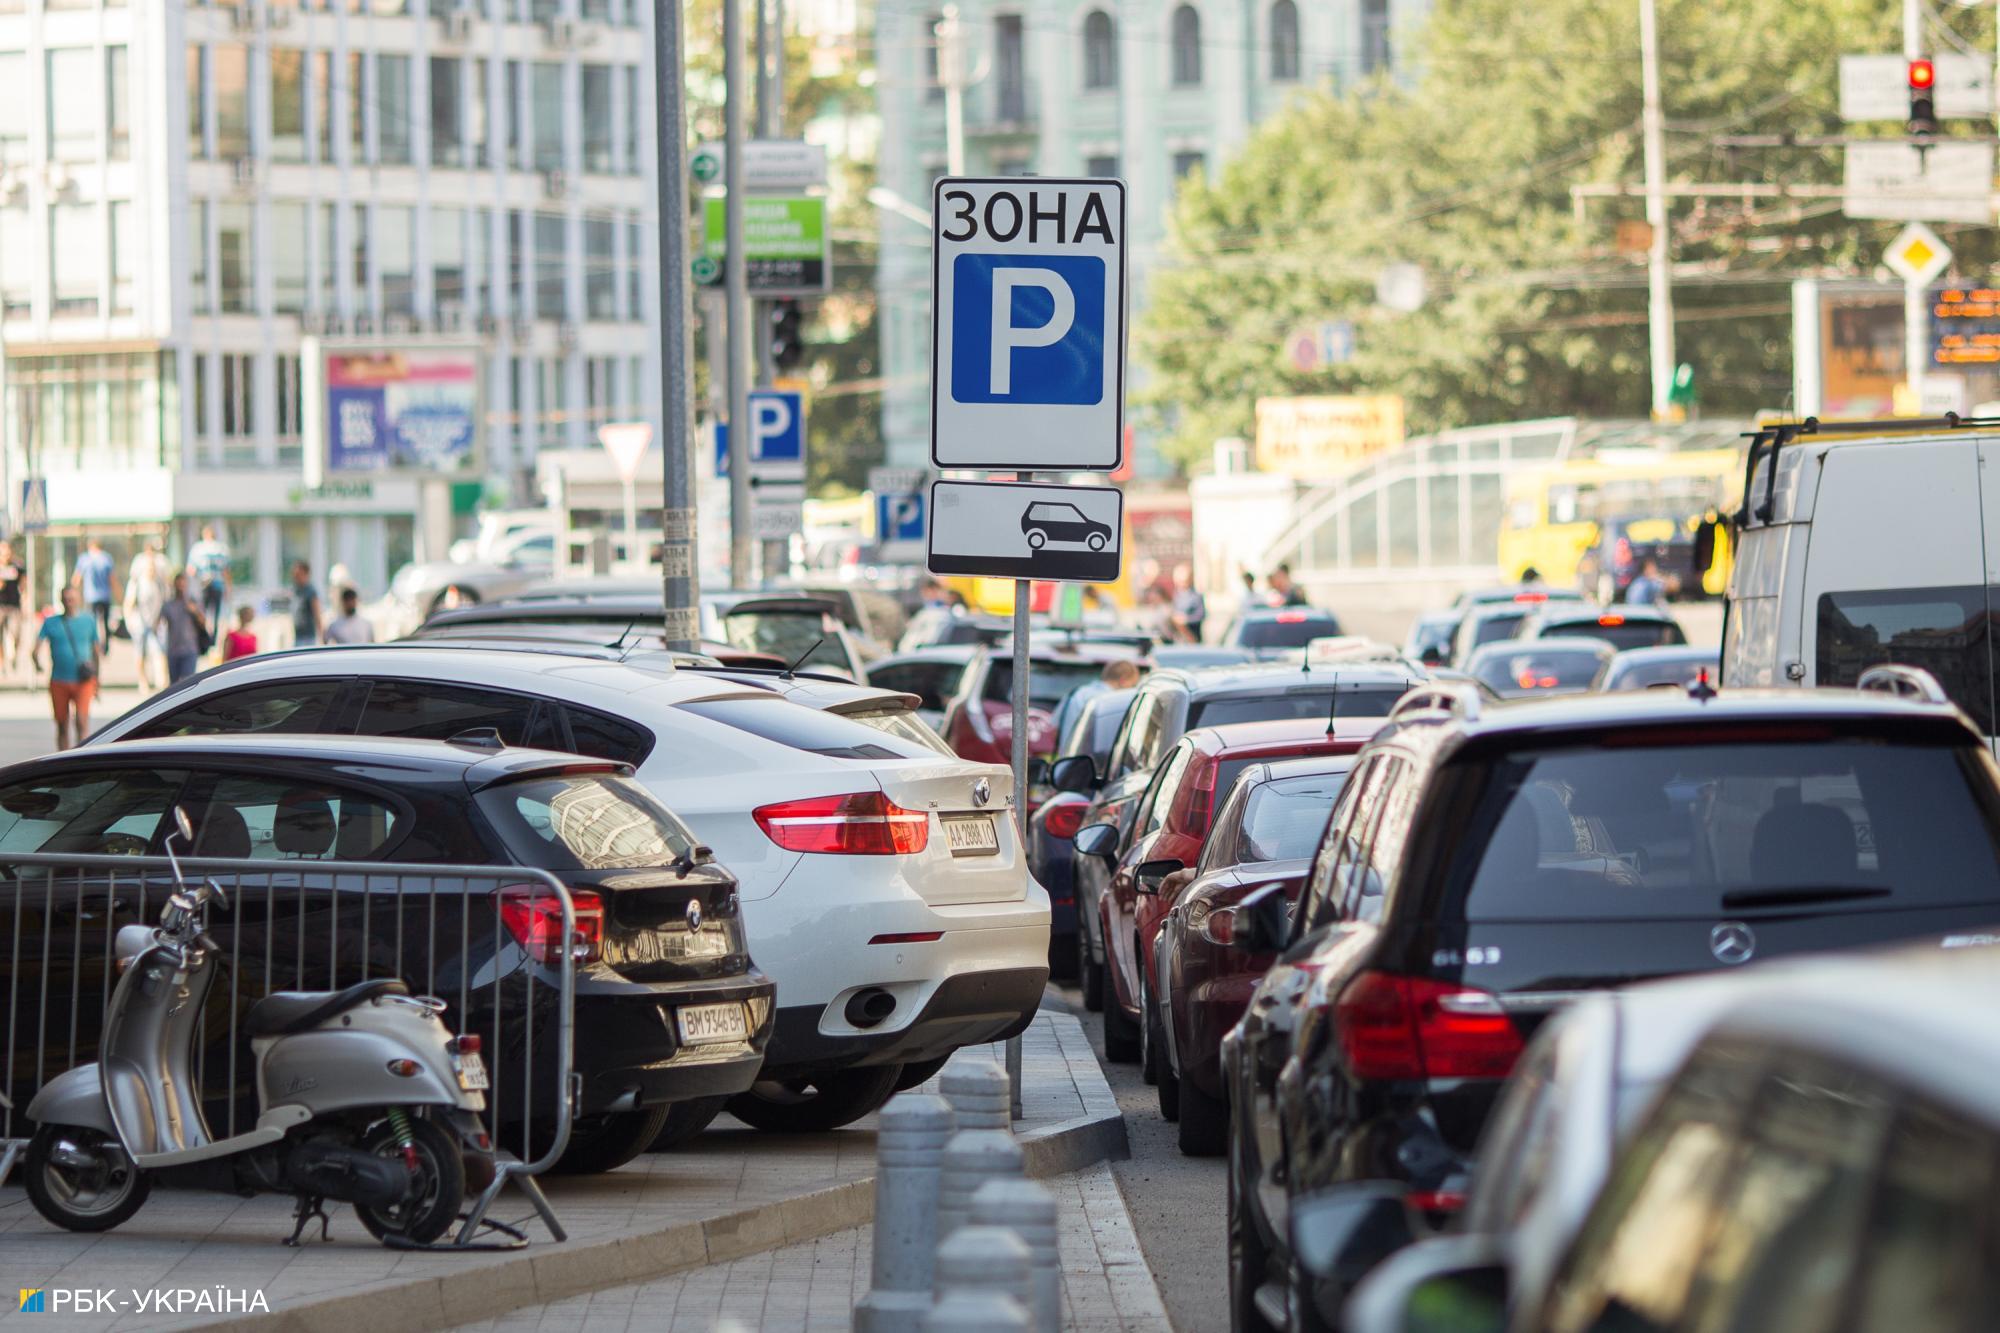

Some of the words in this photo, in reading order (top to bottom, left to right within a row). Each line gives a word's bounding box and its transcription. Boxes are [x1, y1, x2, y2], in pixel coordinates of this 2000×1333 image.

[942, 190, 1115, 244] ЗОНА
[990, 267, 1076, 395] P
[751, 397, 792, 459] P
[949, 824, 965, 847] AA
[685, 1011, 705, 1036] BM
[704, 1009, 728, 1034] 9346
